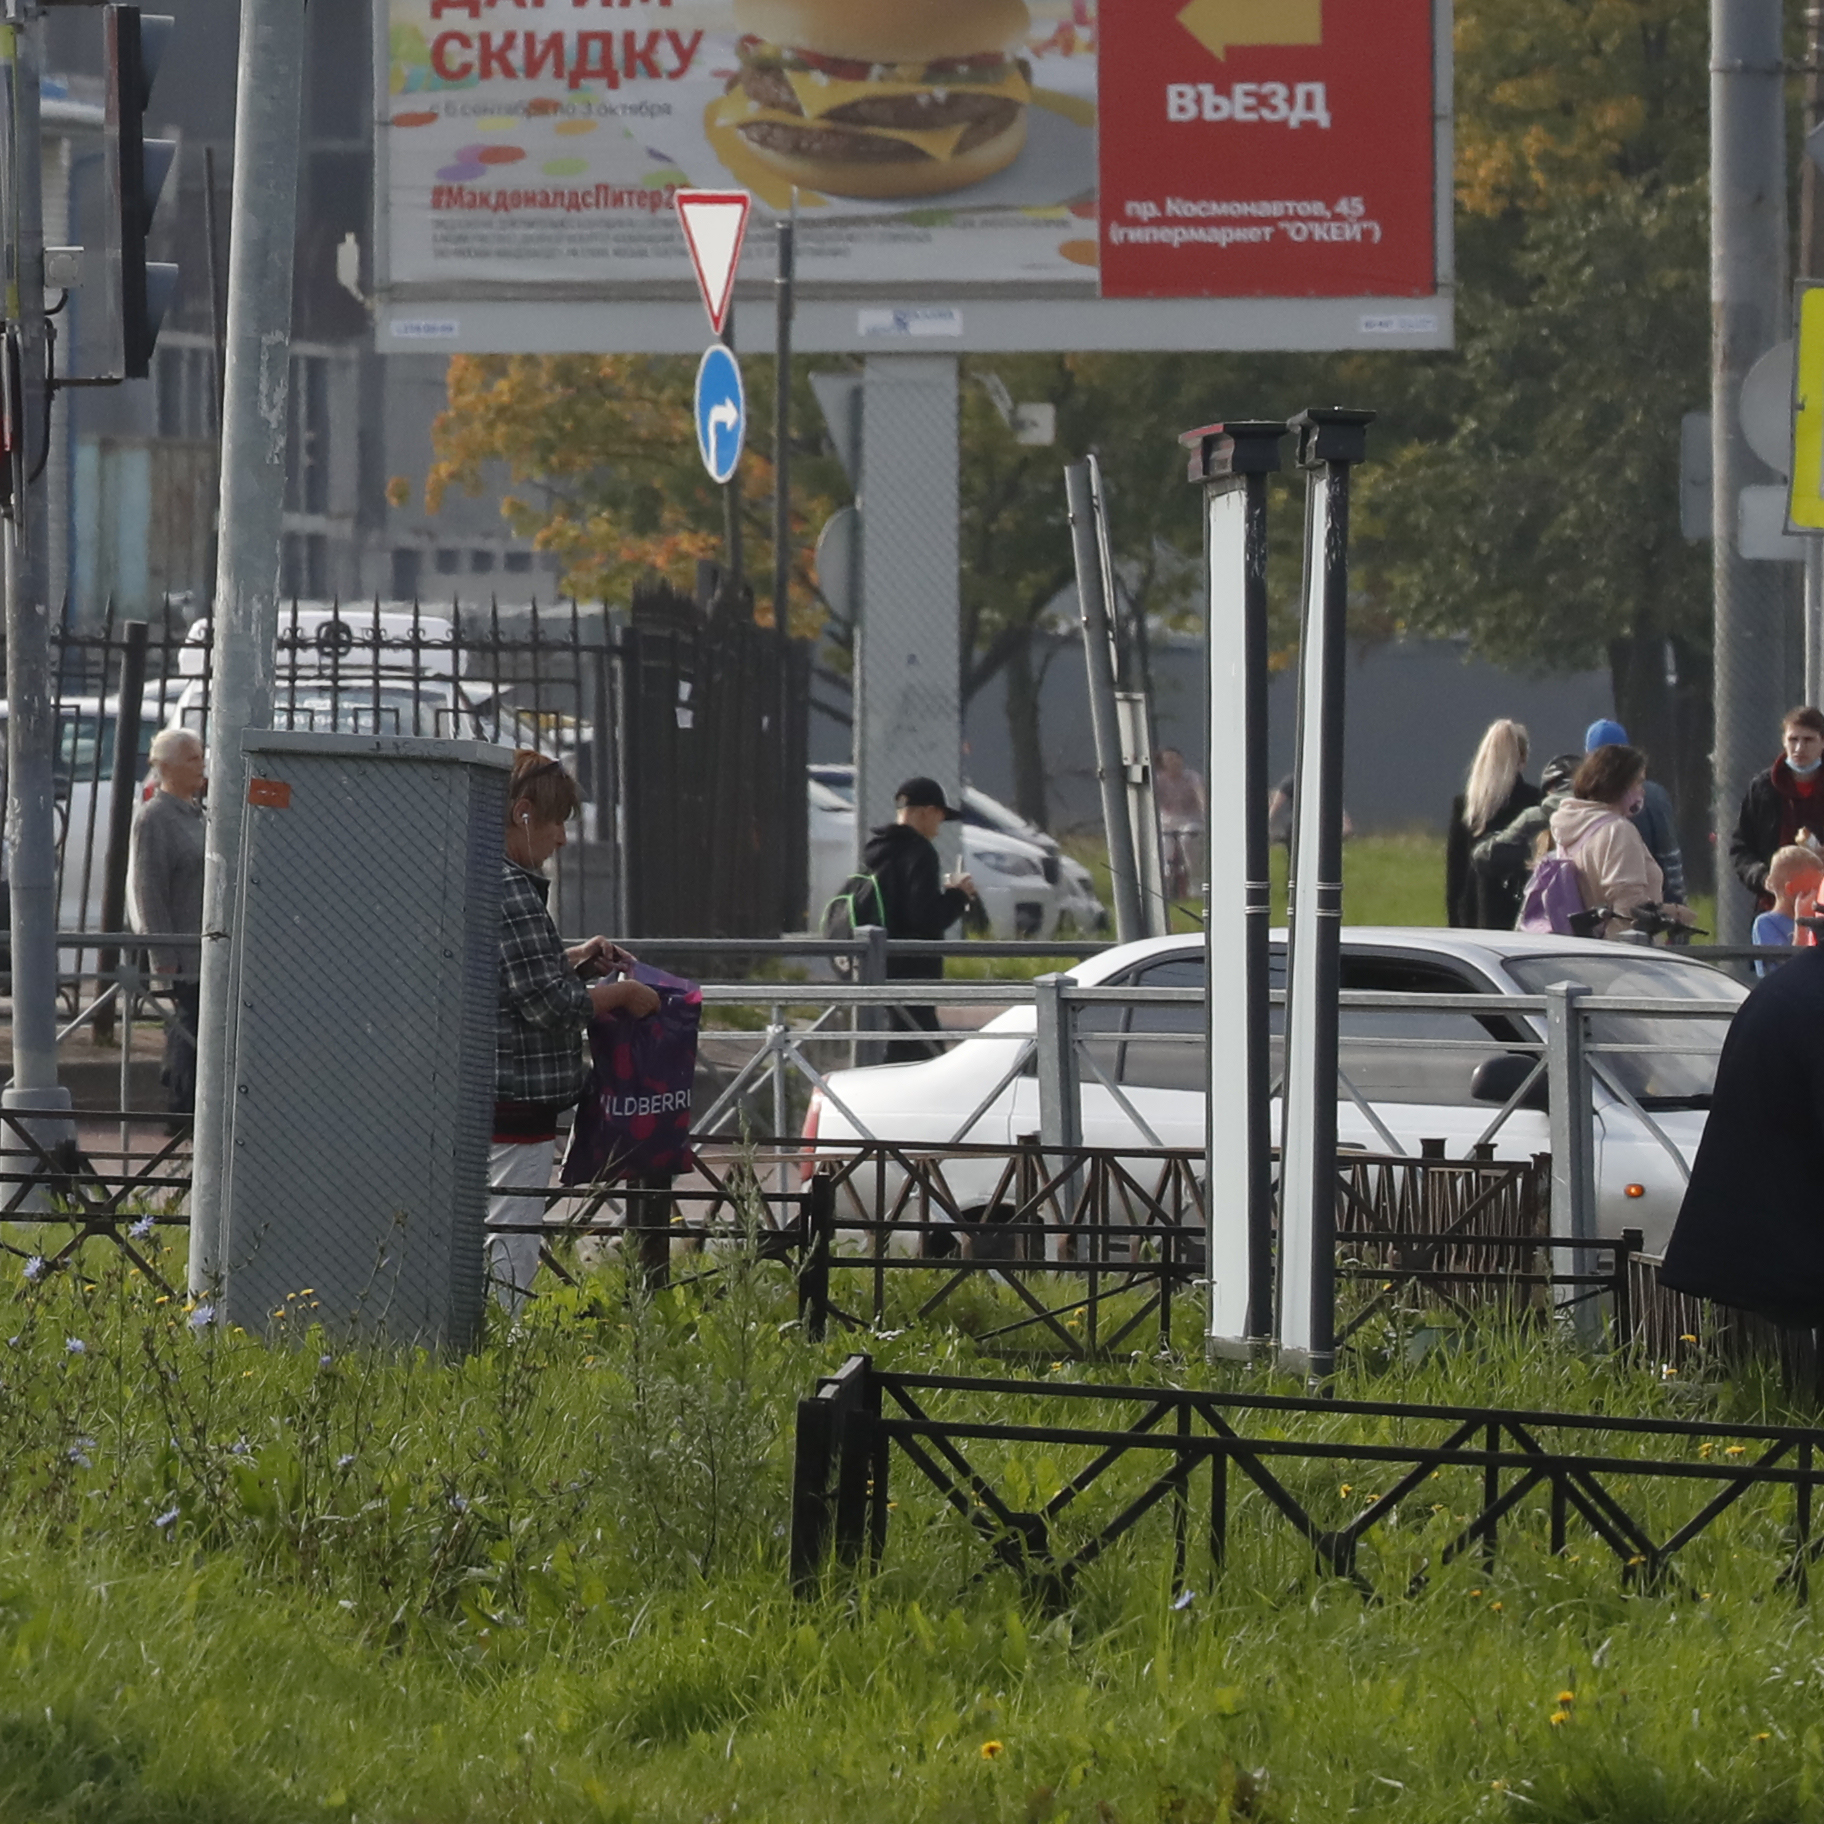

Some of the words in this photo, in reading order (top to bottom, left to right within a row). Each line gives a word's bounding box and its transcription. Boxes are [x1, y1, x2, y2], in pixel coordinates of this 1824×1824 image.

[430, 29, 705, 90] СКИДКУ
[1165, 81, 1332, 130] ВЪЕЗД
[1124, 200, 1162, 222] пр.
[1165, 196, 1331, 220] Космонавтов,
[1334, 195, 1366, 219] 45
[1109, 219, 1275, 248] (гипермаркет
